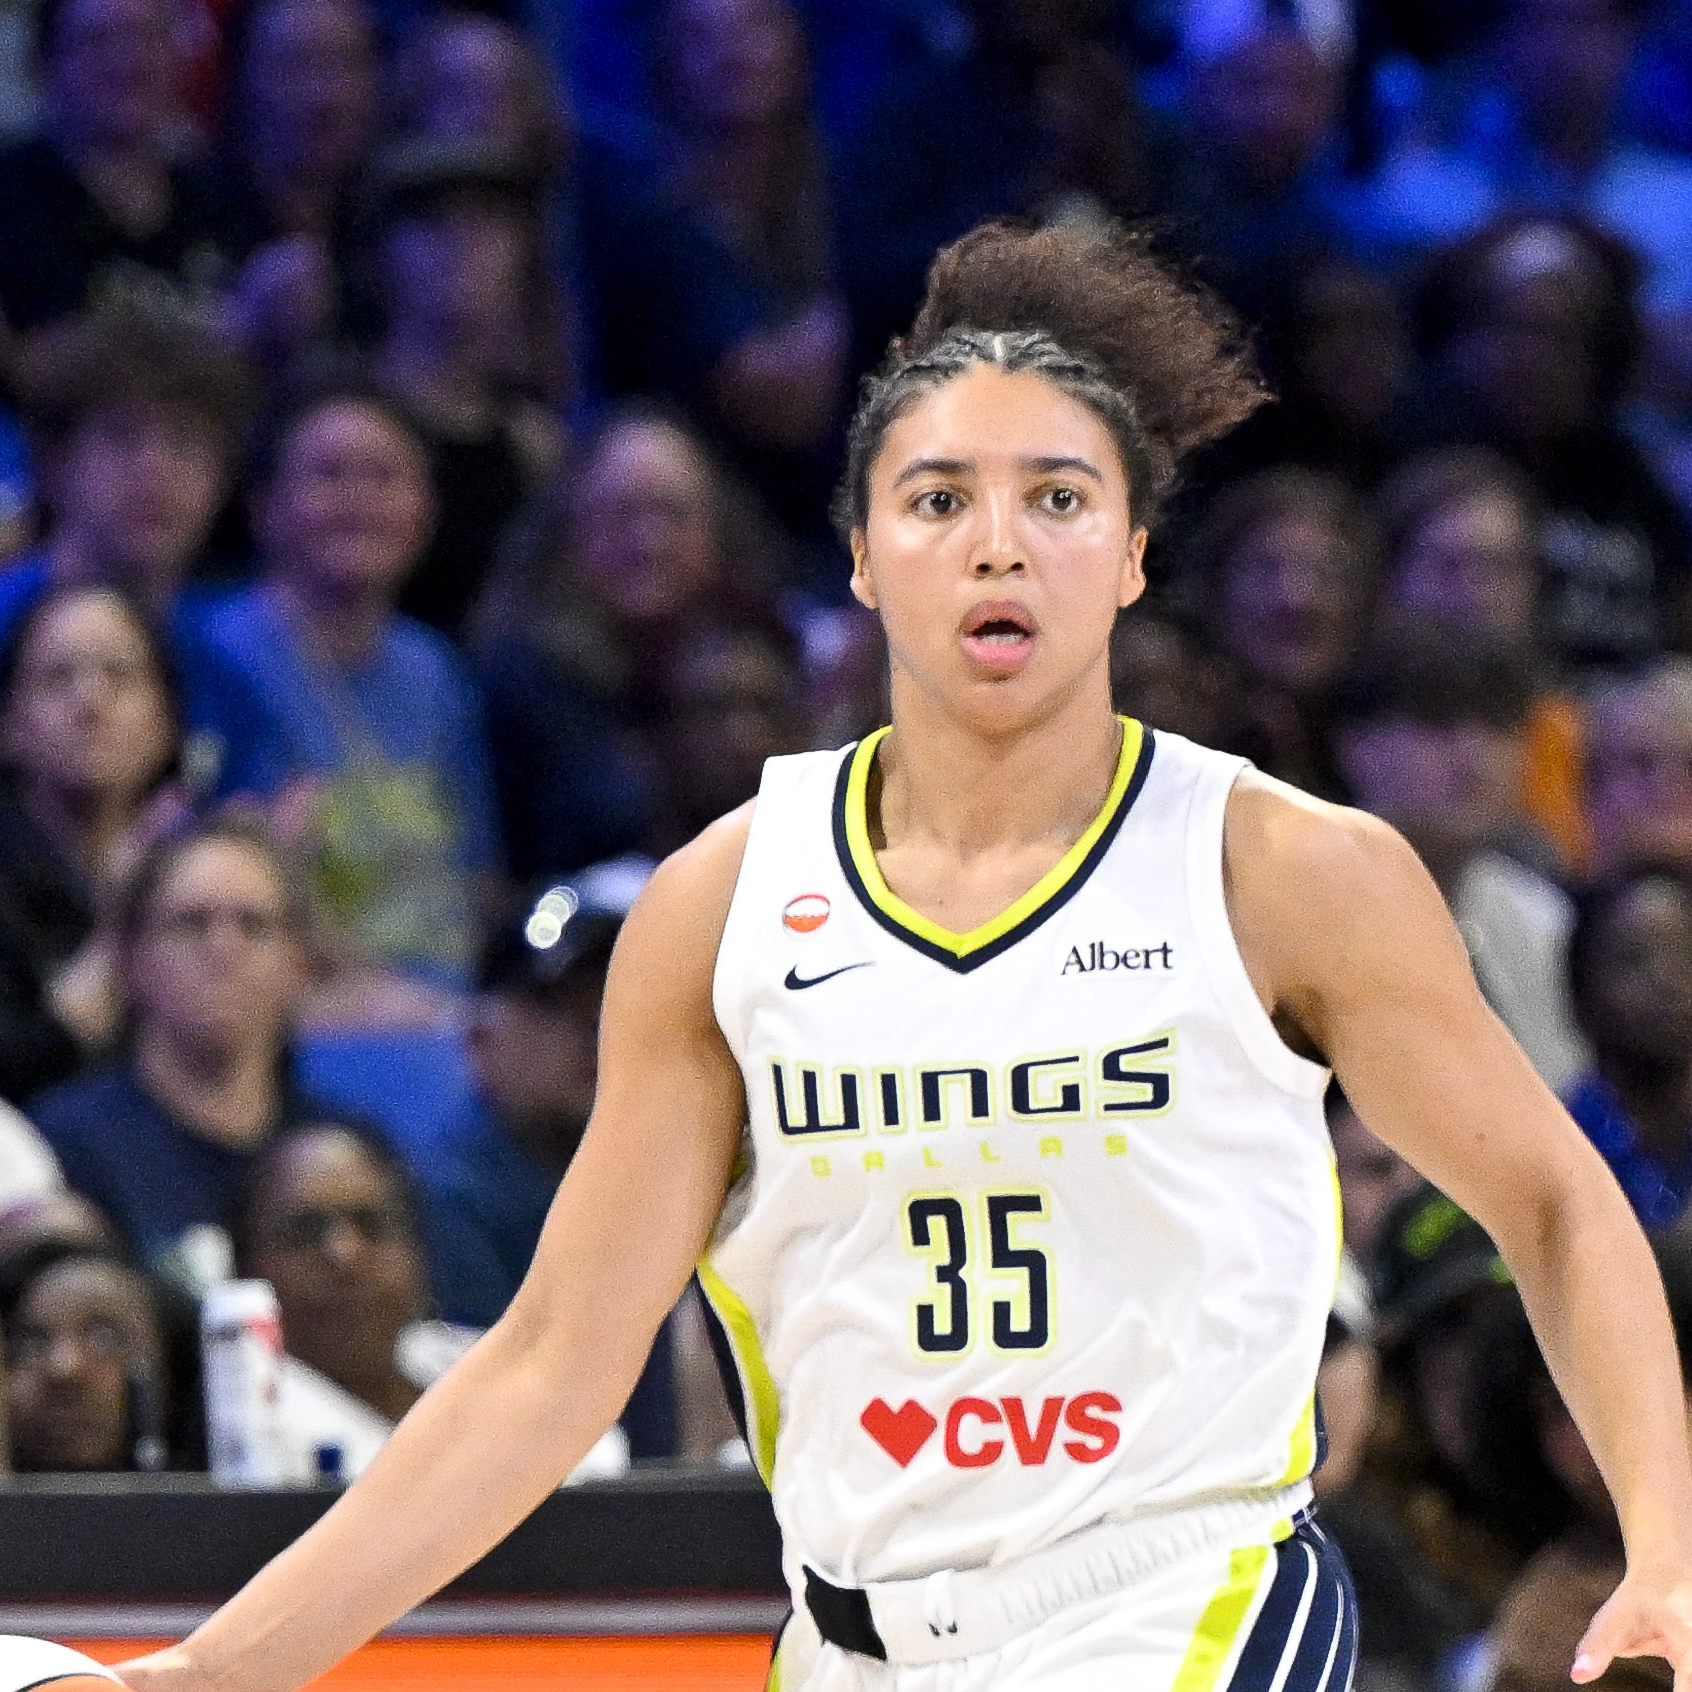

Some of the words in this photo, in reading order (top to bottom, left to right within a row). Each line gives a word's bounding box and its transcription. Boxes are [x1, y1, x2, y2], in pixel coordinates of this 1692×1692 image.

[1060, 939, 1175, 976] Albert
[767, 1028, 1176, 1144] WINGS
[906, 1189, 1059, 1361] 35
[944, 1390, 1123, 1468] CVS
